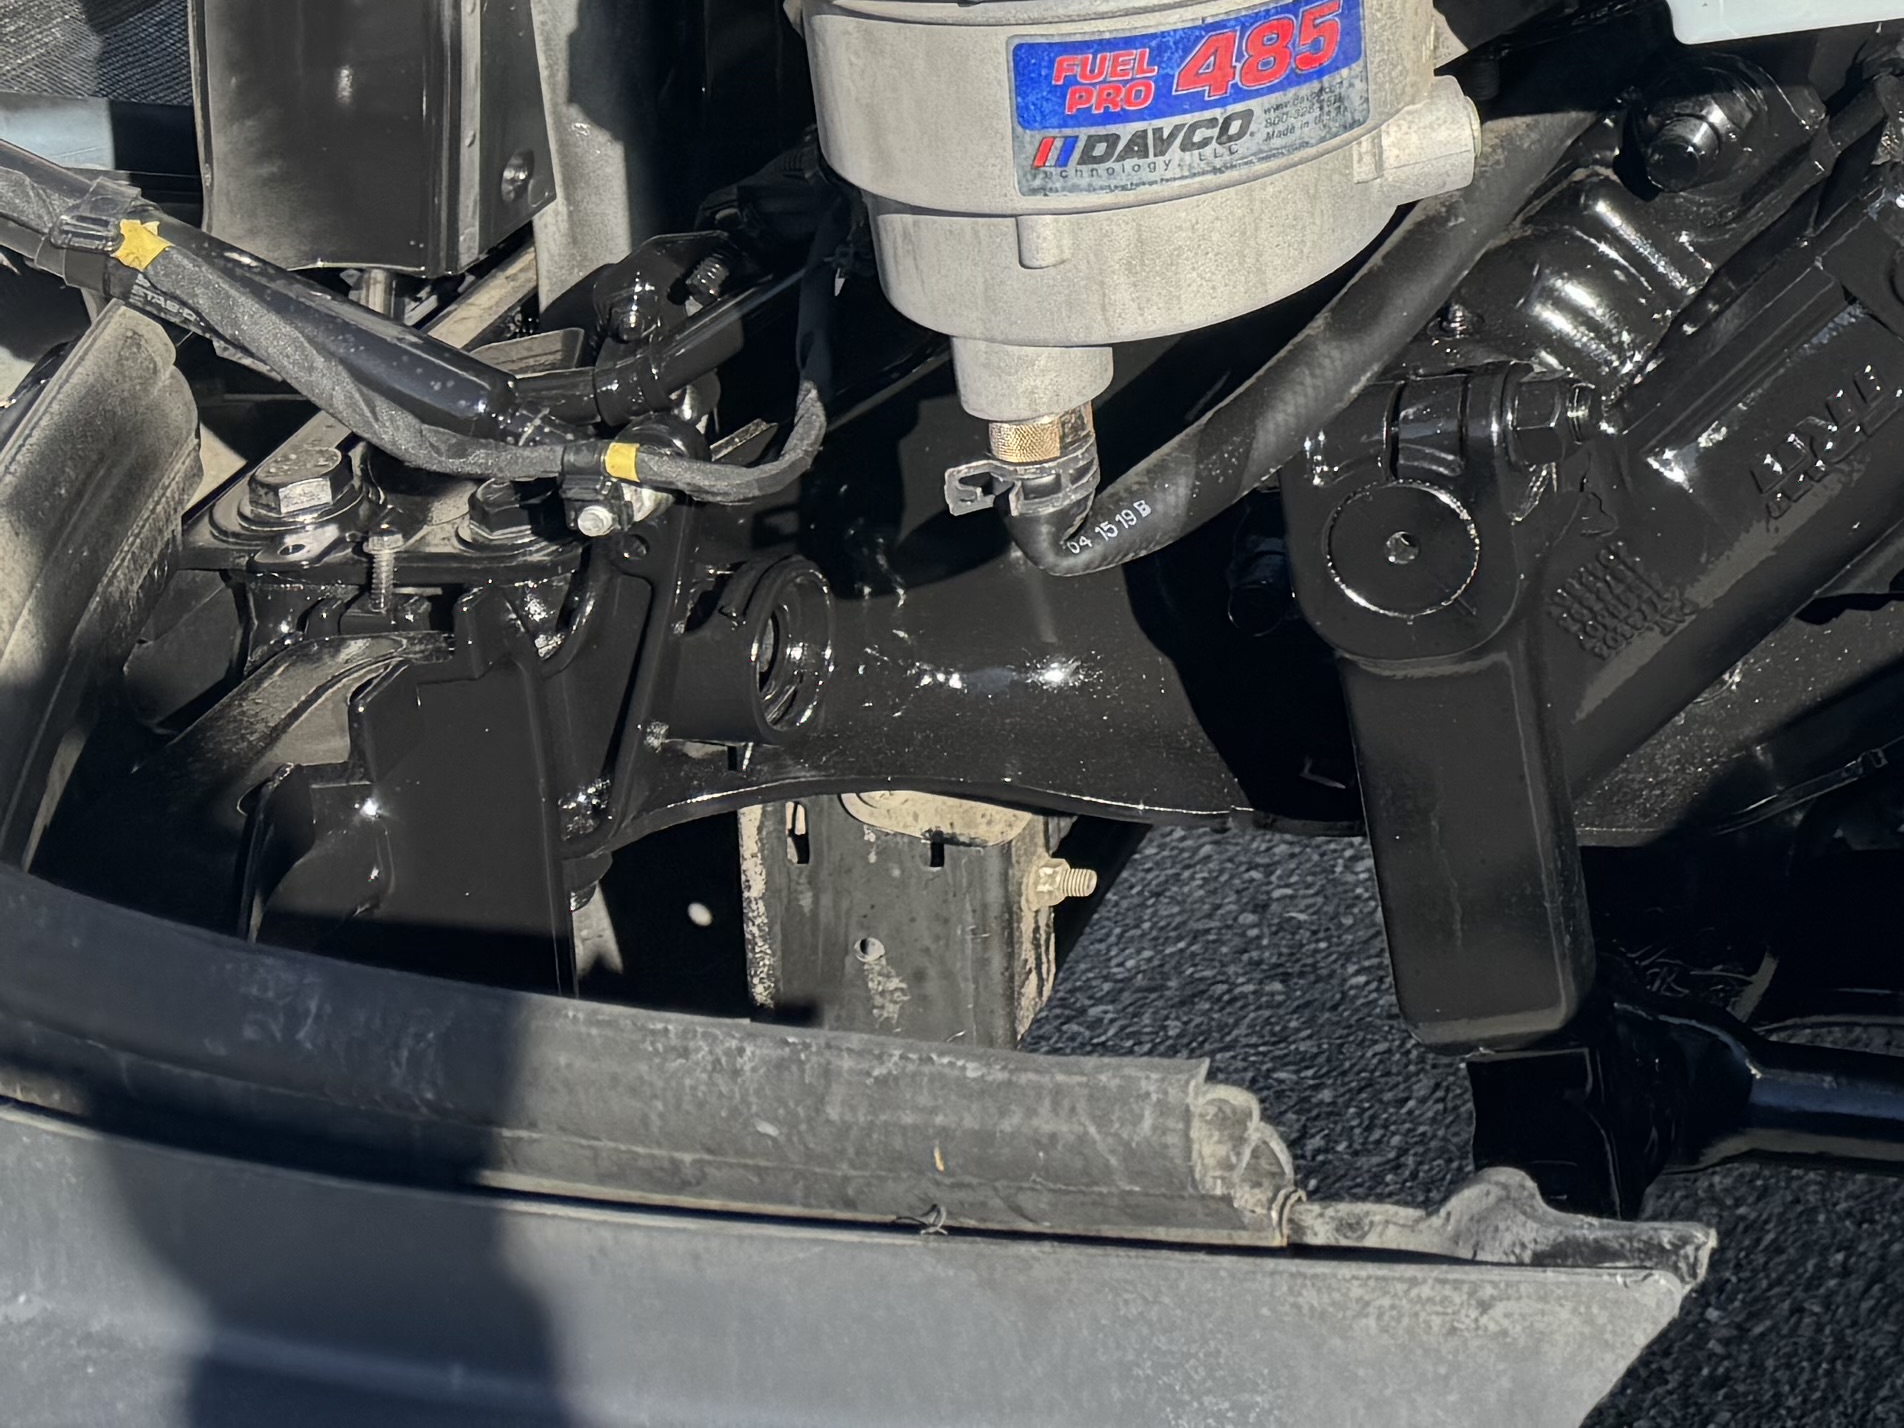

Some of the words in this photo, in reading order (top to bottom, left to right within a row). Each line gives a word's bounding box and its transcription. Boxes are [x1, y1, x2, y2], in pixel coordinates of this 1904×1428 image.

[1051, 48, 1159, 86] FUEL
[1064, 79, 1156, 116] PRO
[1077, 108, 1255, 168] DAVCO
[1262, 124, 1296, 143] Made
[1299, 119, 1310, 130] in
[1067, 535, 1092, 554] 04
[1095, 521, 1118, 541] 15
[1115, 509, 1137, 529] 19
[1133, 500, 1152, 517] B
